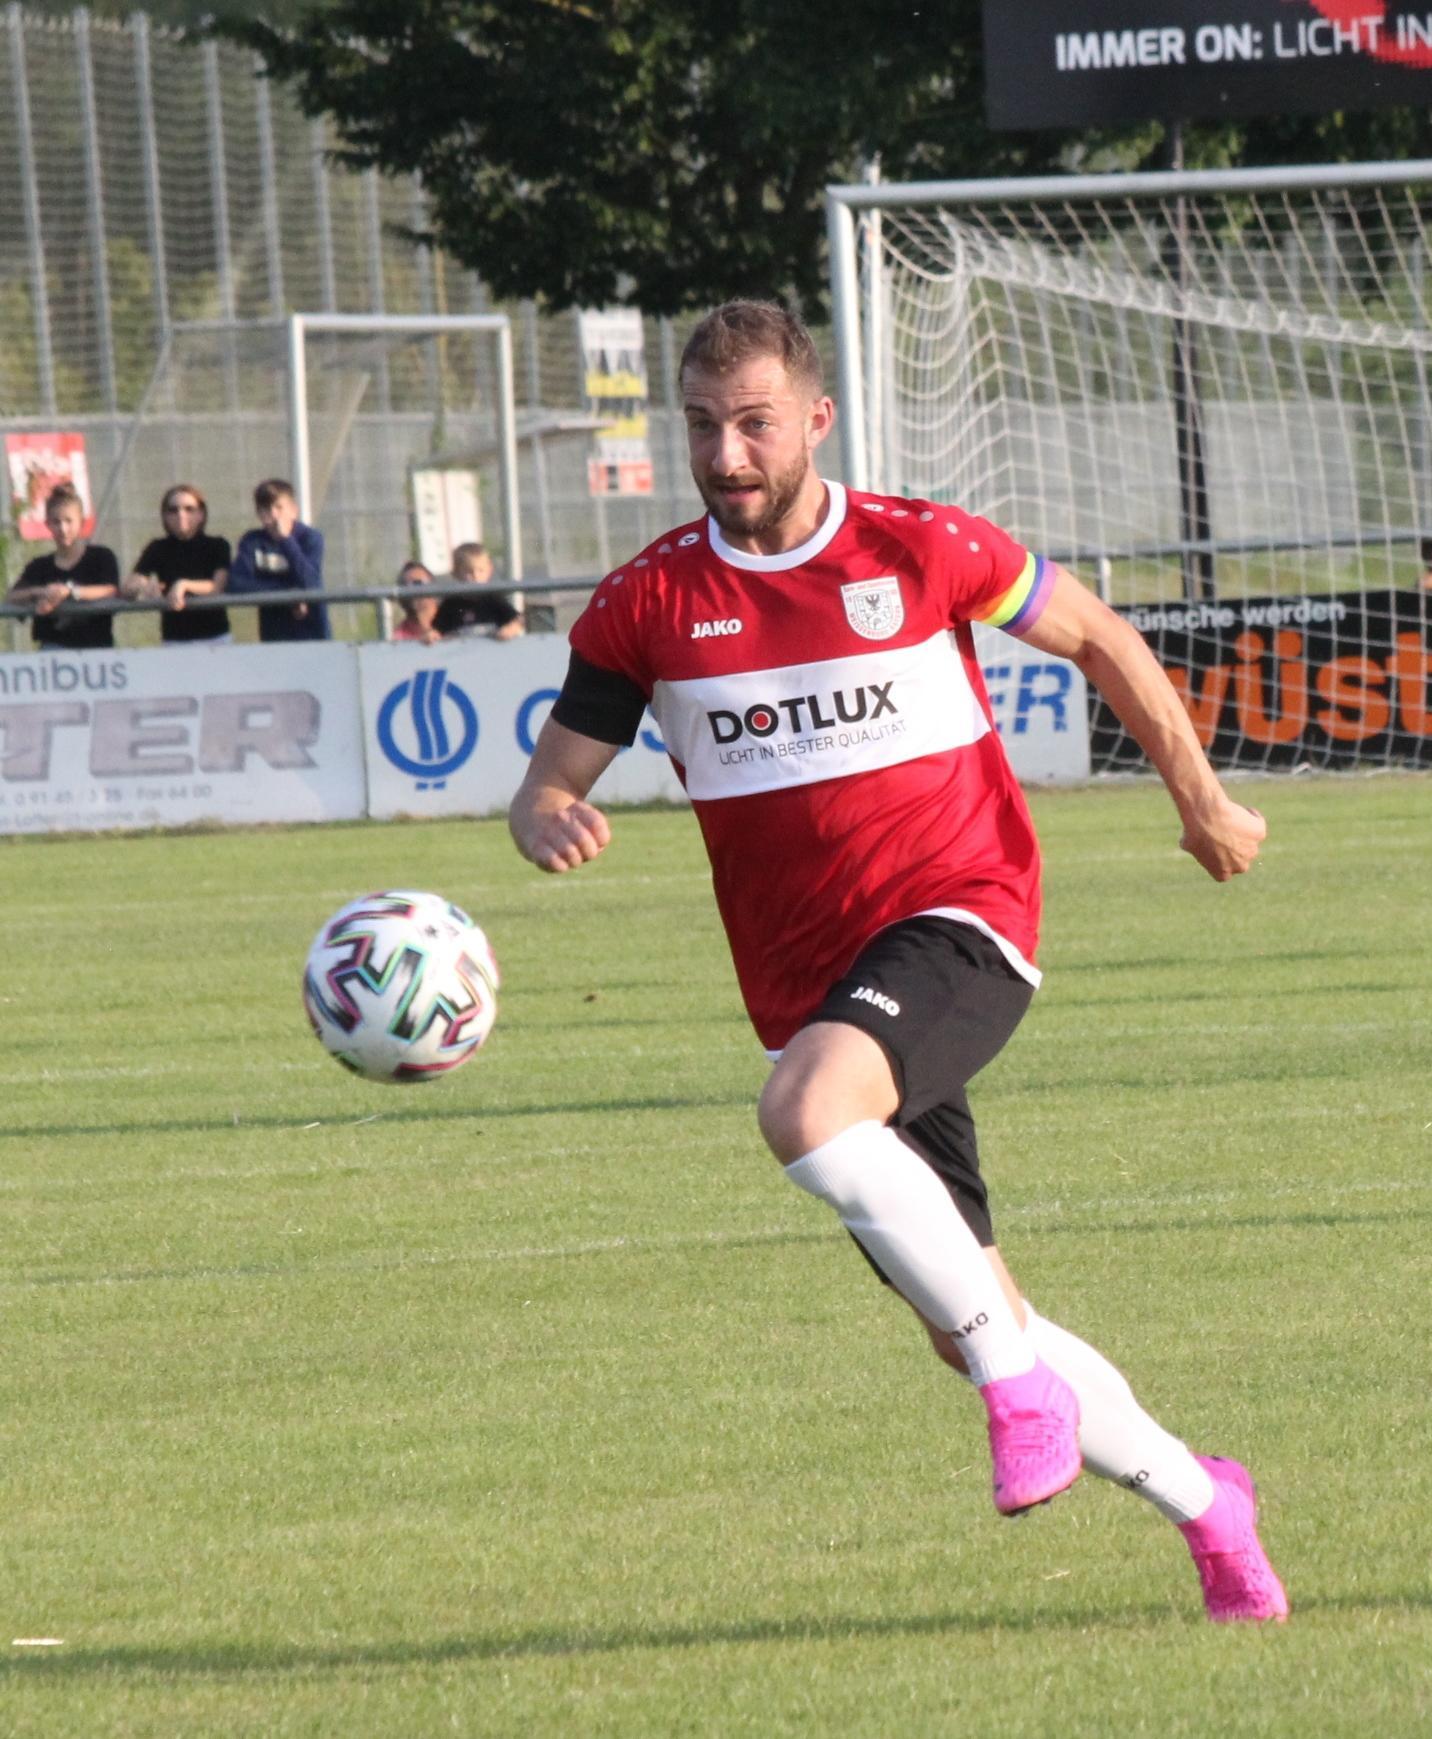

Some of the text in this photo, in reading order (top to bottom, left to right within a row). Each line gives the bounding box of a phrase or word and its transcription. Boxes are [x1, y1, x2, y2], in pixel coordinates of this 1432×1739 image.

[1056, 26, 1186, 71] IMMER
[1195, 22, 1263, 62] ON:
[1274, 15, 1384, 58] LICHT
[691, 618, 743, 639] JAKO
[1242, 599, 1346, 629] werden
[706, 680, 899, 745] DOTLUX
[760, 745, 774, 760] IN
[777, 736, 834, 758] BESTER
[849, 986, 900, 1017] JAKO
